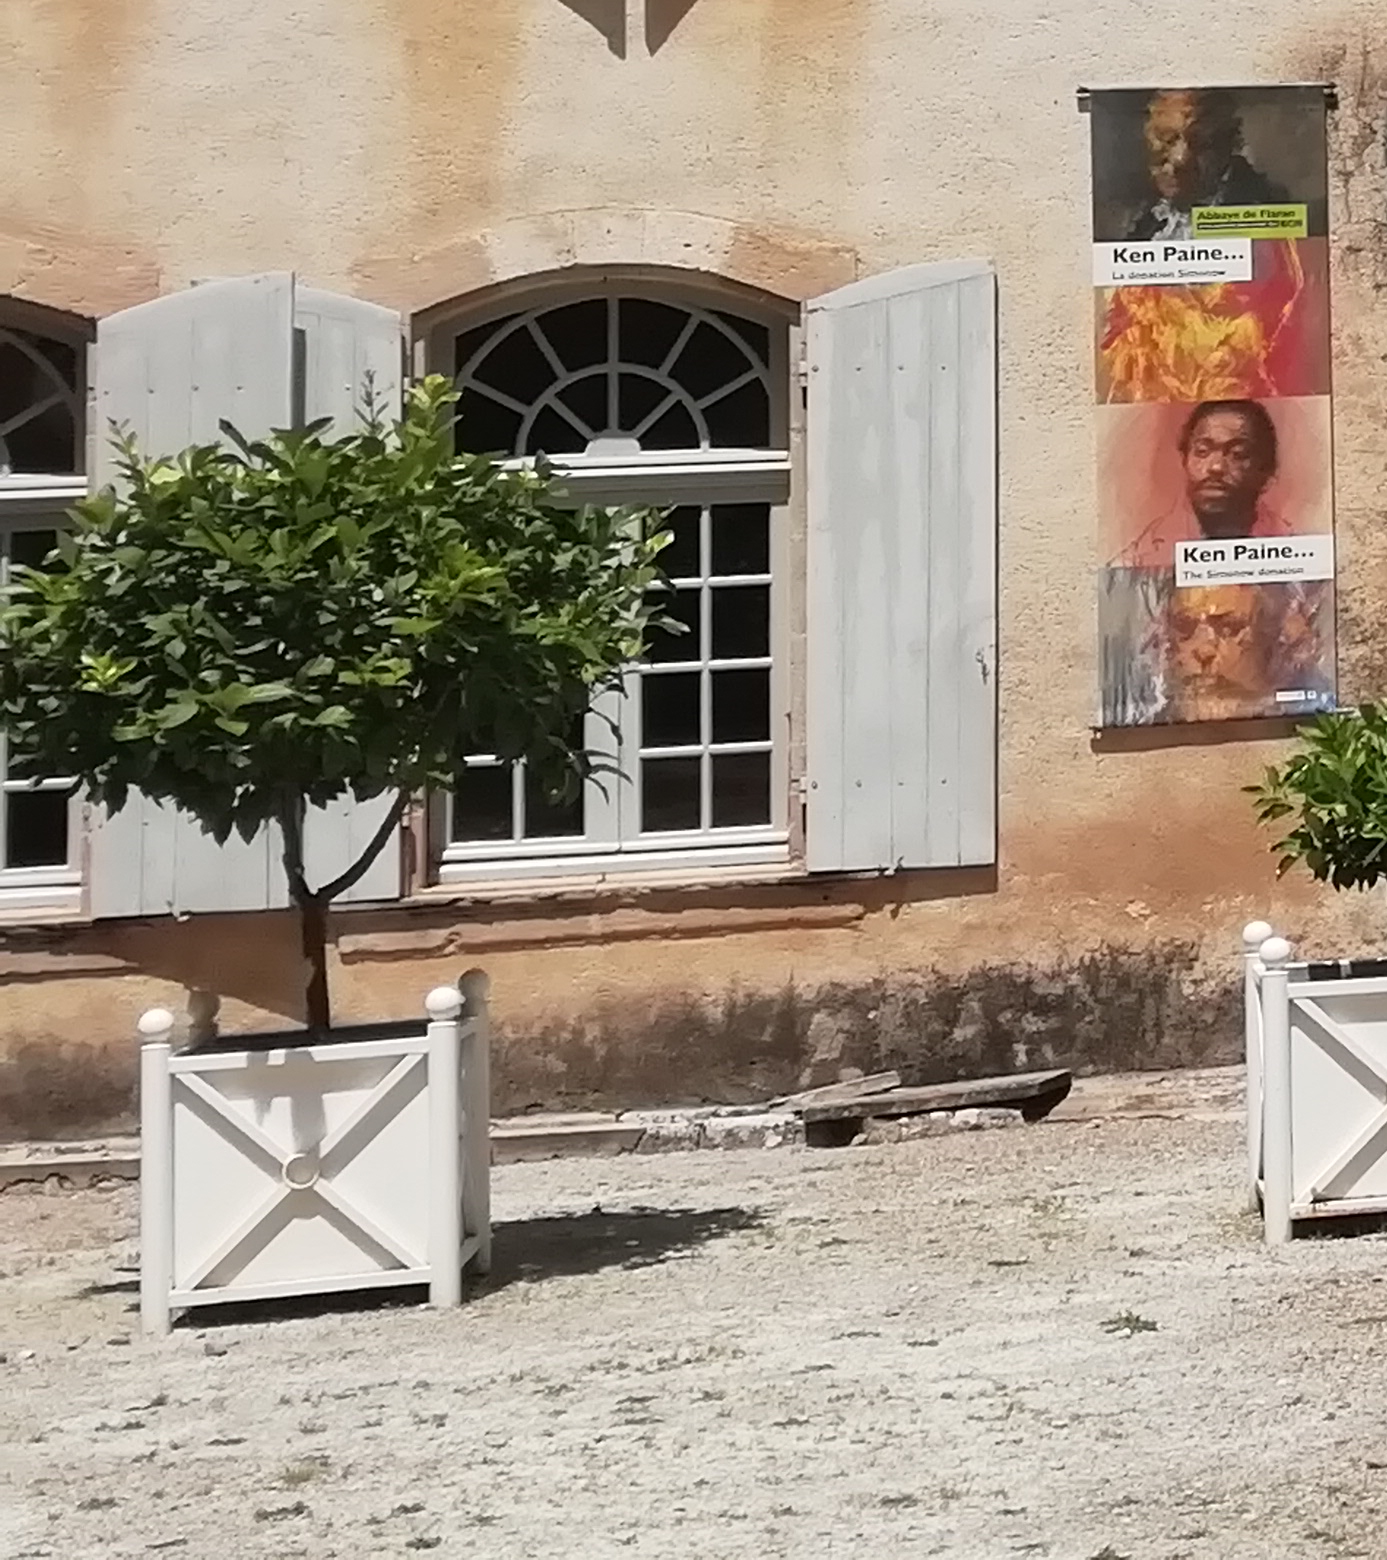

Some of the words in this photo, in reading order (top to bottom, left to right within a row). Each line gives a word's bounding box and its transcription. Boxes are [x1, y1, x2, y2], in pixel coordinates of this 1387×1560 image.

[1243, 209, 1256, 219] de
[1113, 247, 1155, 263] Ken
[1163, 245, 1244, 262] Paine...
[1112, 272, 1124, 280] La
[1183, 547, 1225, 563] Ken
[1234, 544, 1314, 560] Paine...
[1183, 570, 1202, 580] The
